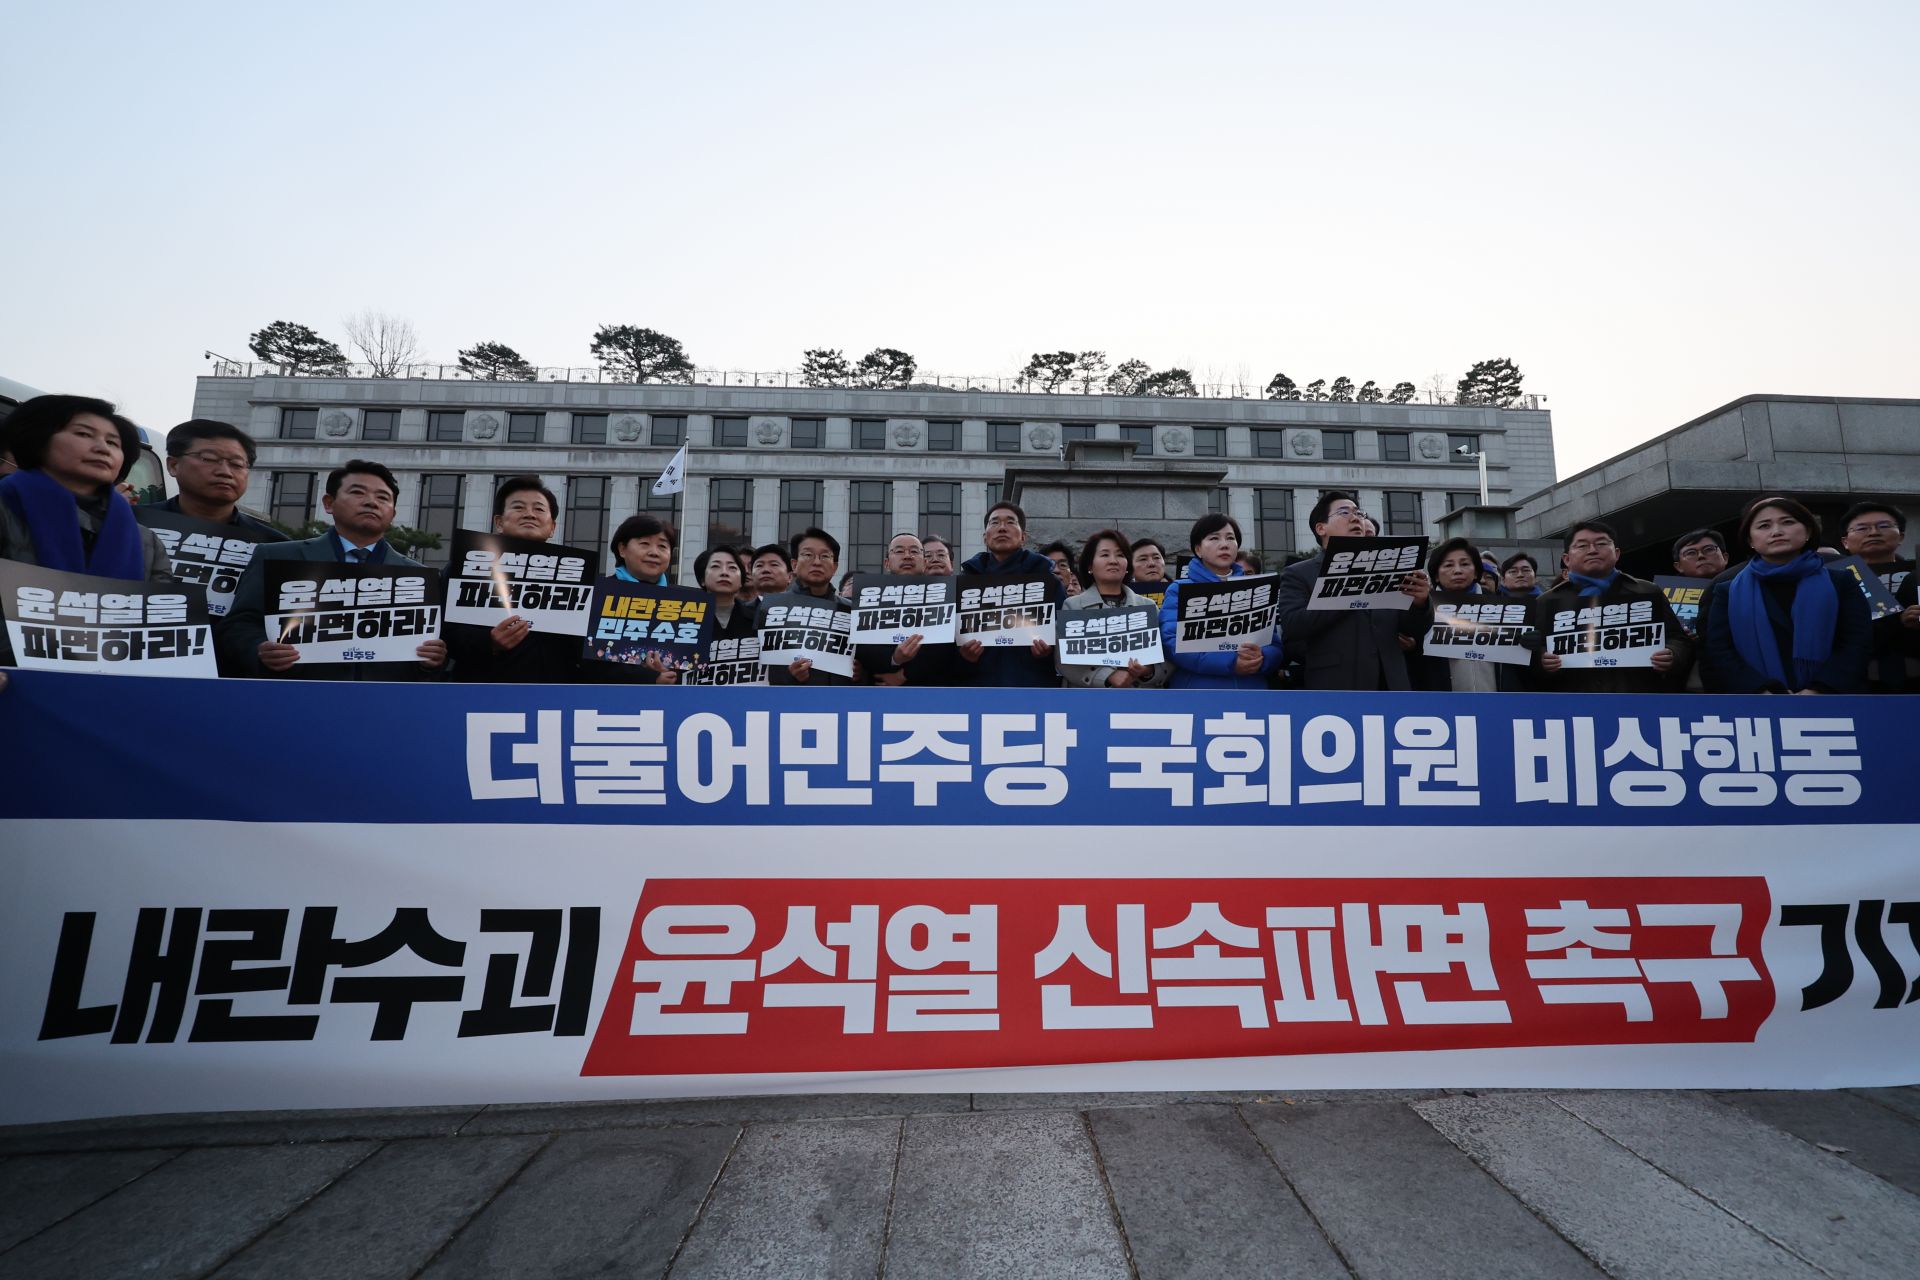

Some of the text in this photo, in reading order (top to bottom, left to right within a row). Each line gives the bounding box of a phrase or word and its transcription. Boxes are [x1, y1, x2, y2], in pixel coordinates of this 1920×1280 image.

[461, 550, 586, 582] 윤석열을
[1327, 545, 1420, 575] 윤석열을
[17, 586, 188, 624] 윤석열을
[278, 576, 426, 611] 윤석열을
[456, 581, 592, 611] 파면하라!
[859, 583, 947, 608] 윤석열을
[960, 582, 1045, 610] 윤석열을
[1185, 584, 1271, 618] 윤석열을
[602, 595, 707, 623] 내란 종식
[765, 606, 850, 632] 윤석열을
[856, 605, 955, 632] 파면하라!
[960, 605, 1053, 634] 파면하라!
[1065, 611, 1148, 637] 윤석열을
[1182, 606, 1274, 642] 파면하라!
[1434, 604, 1527, 624] 윤석열을
[1553, 601, 1653, 633] 윤석열을
[276, 608, 438, 645] 파면하라!
[596, 617, 701, 644] 민주 수호
[1552, 624, 1663, 656] 파면하라!
[21, 625, 207, 661] 파면하라!
[342, 650, 376, 660] 민주당
[762, 630, 854, 656] 파면하라!
[1066, 630, 1157, 655] 파면하라!
[466, 708, 1862, 807] 더불어민주당 국회의원 비상행동
[38, 905, 601, 1044] 내란수괴
[628, 903, 1000, 1036] 윤석열
[1034, 902, 1512, 1030] 신속파면
[1524, 899, 1763, 1022] 촉구
